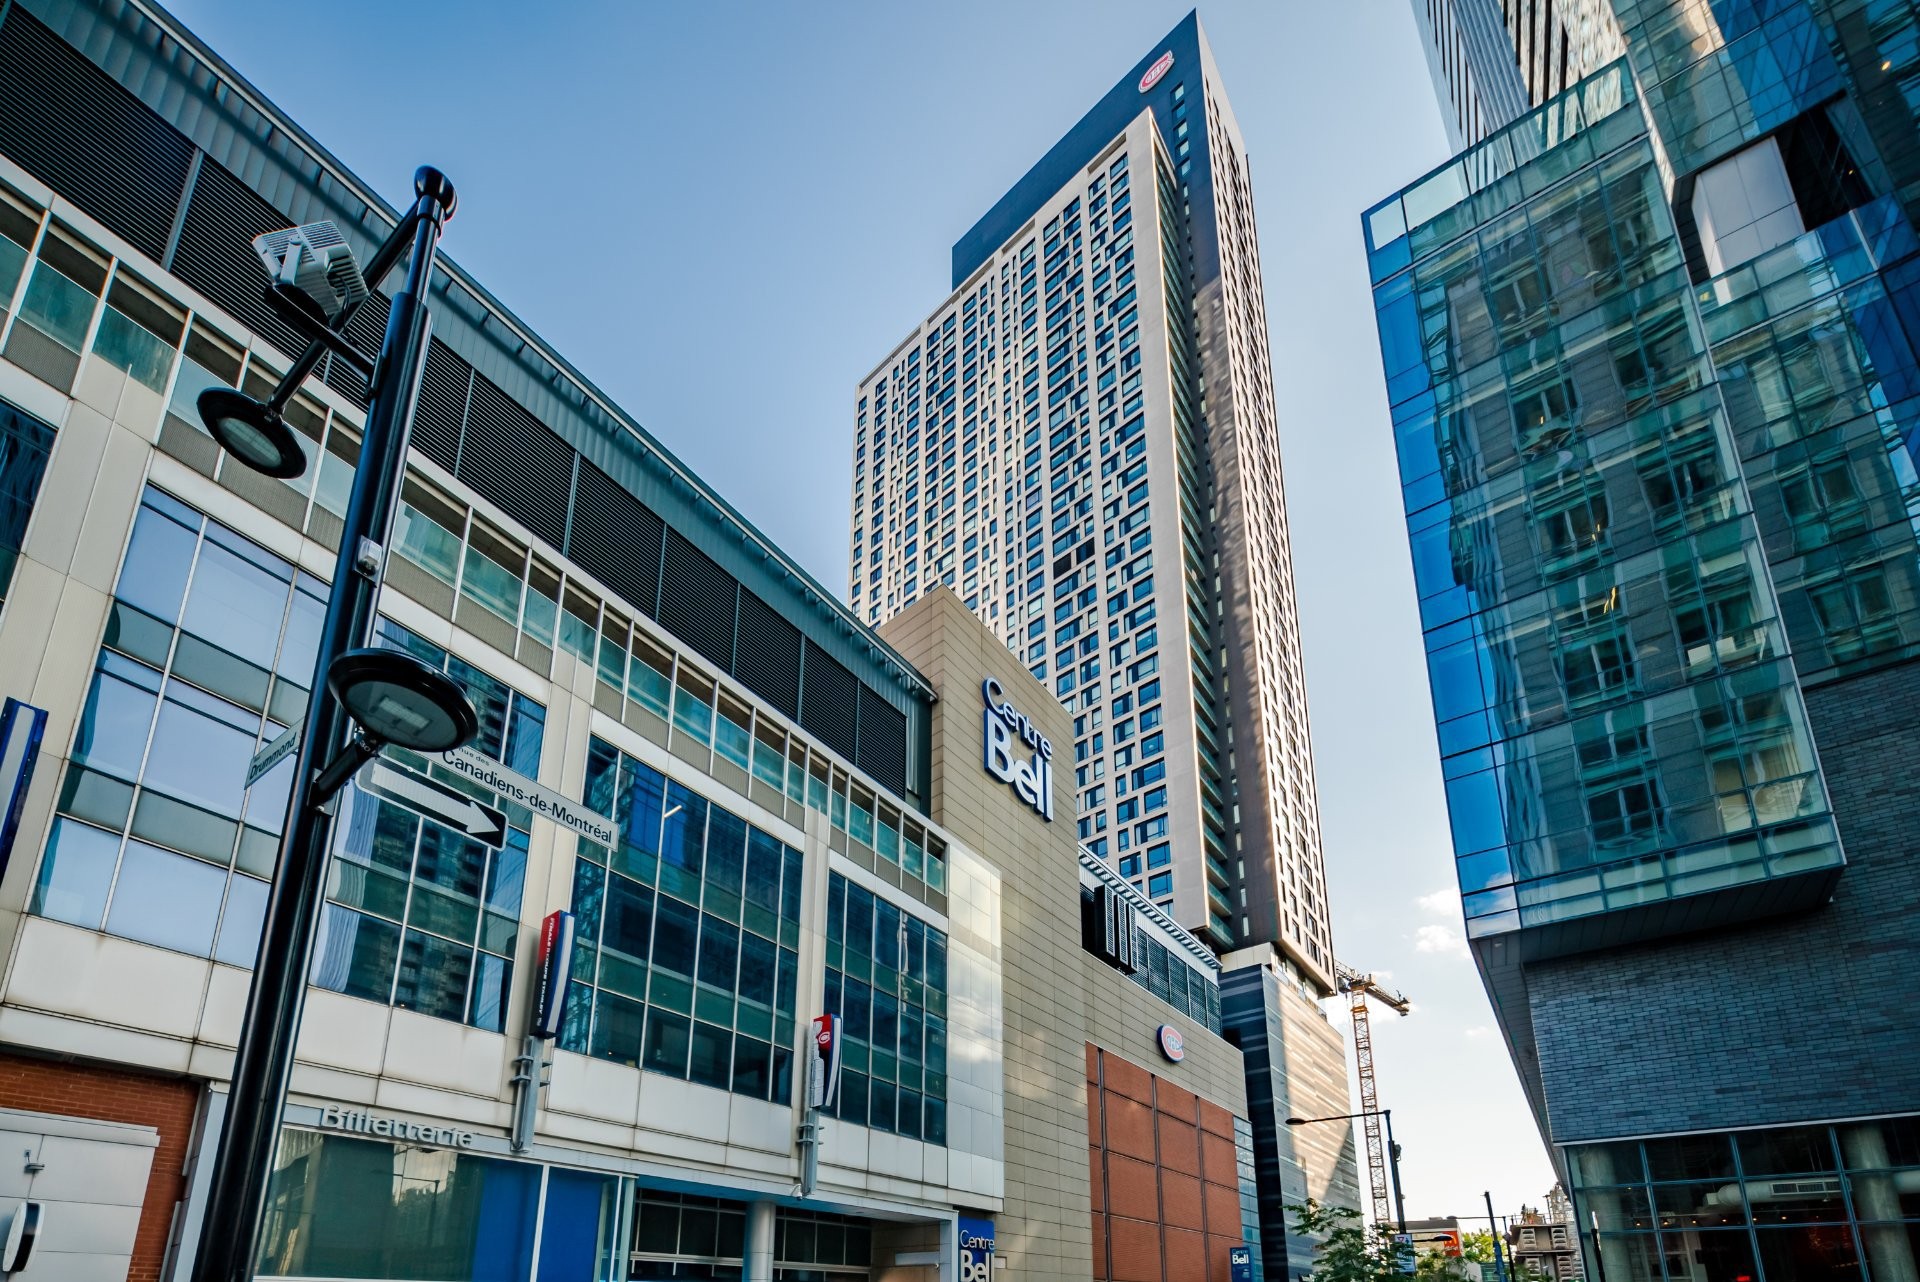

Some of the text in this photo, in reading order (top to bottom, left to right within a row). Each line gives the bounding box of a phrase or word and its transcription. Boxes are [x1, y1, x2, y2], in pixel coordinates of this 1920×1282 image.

[982, 677, 1053, 762] Centre
[250, 732, 297, 780] Drummond
[475, 755, 490, 767] des
[984, 708, 1054, 822] Bell
[442, 750, 612, 844] Canadiens-de-Montréal
[321, 1104, 474, 1148] Billetterie
[960, 1230, 995, 1250] Centre
[1232, 1254, 1249, 1264] Bell
[960, 1249, 995, 1282] Bell
